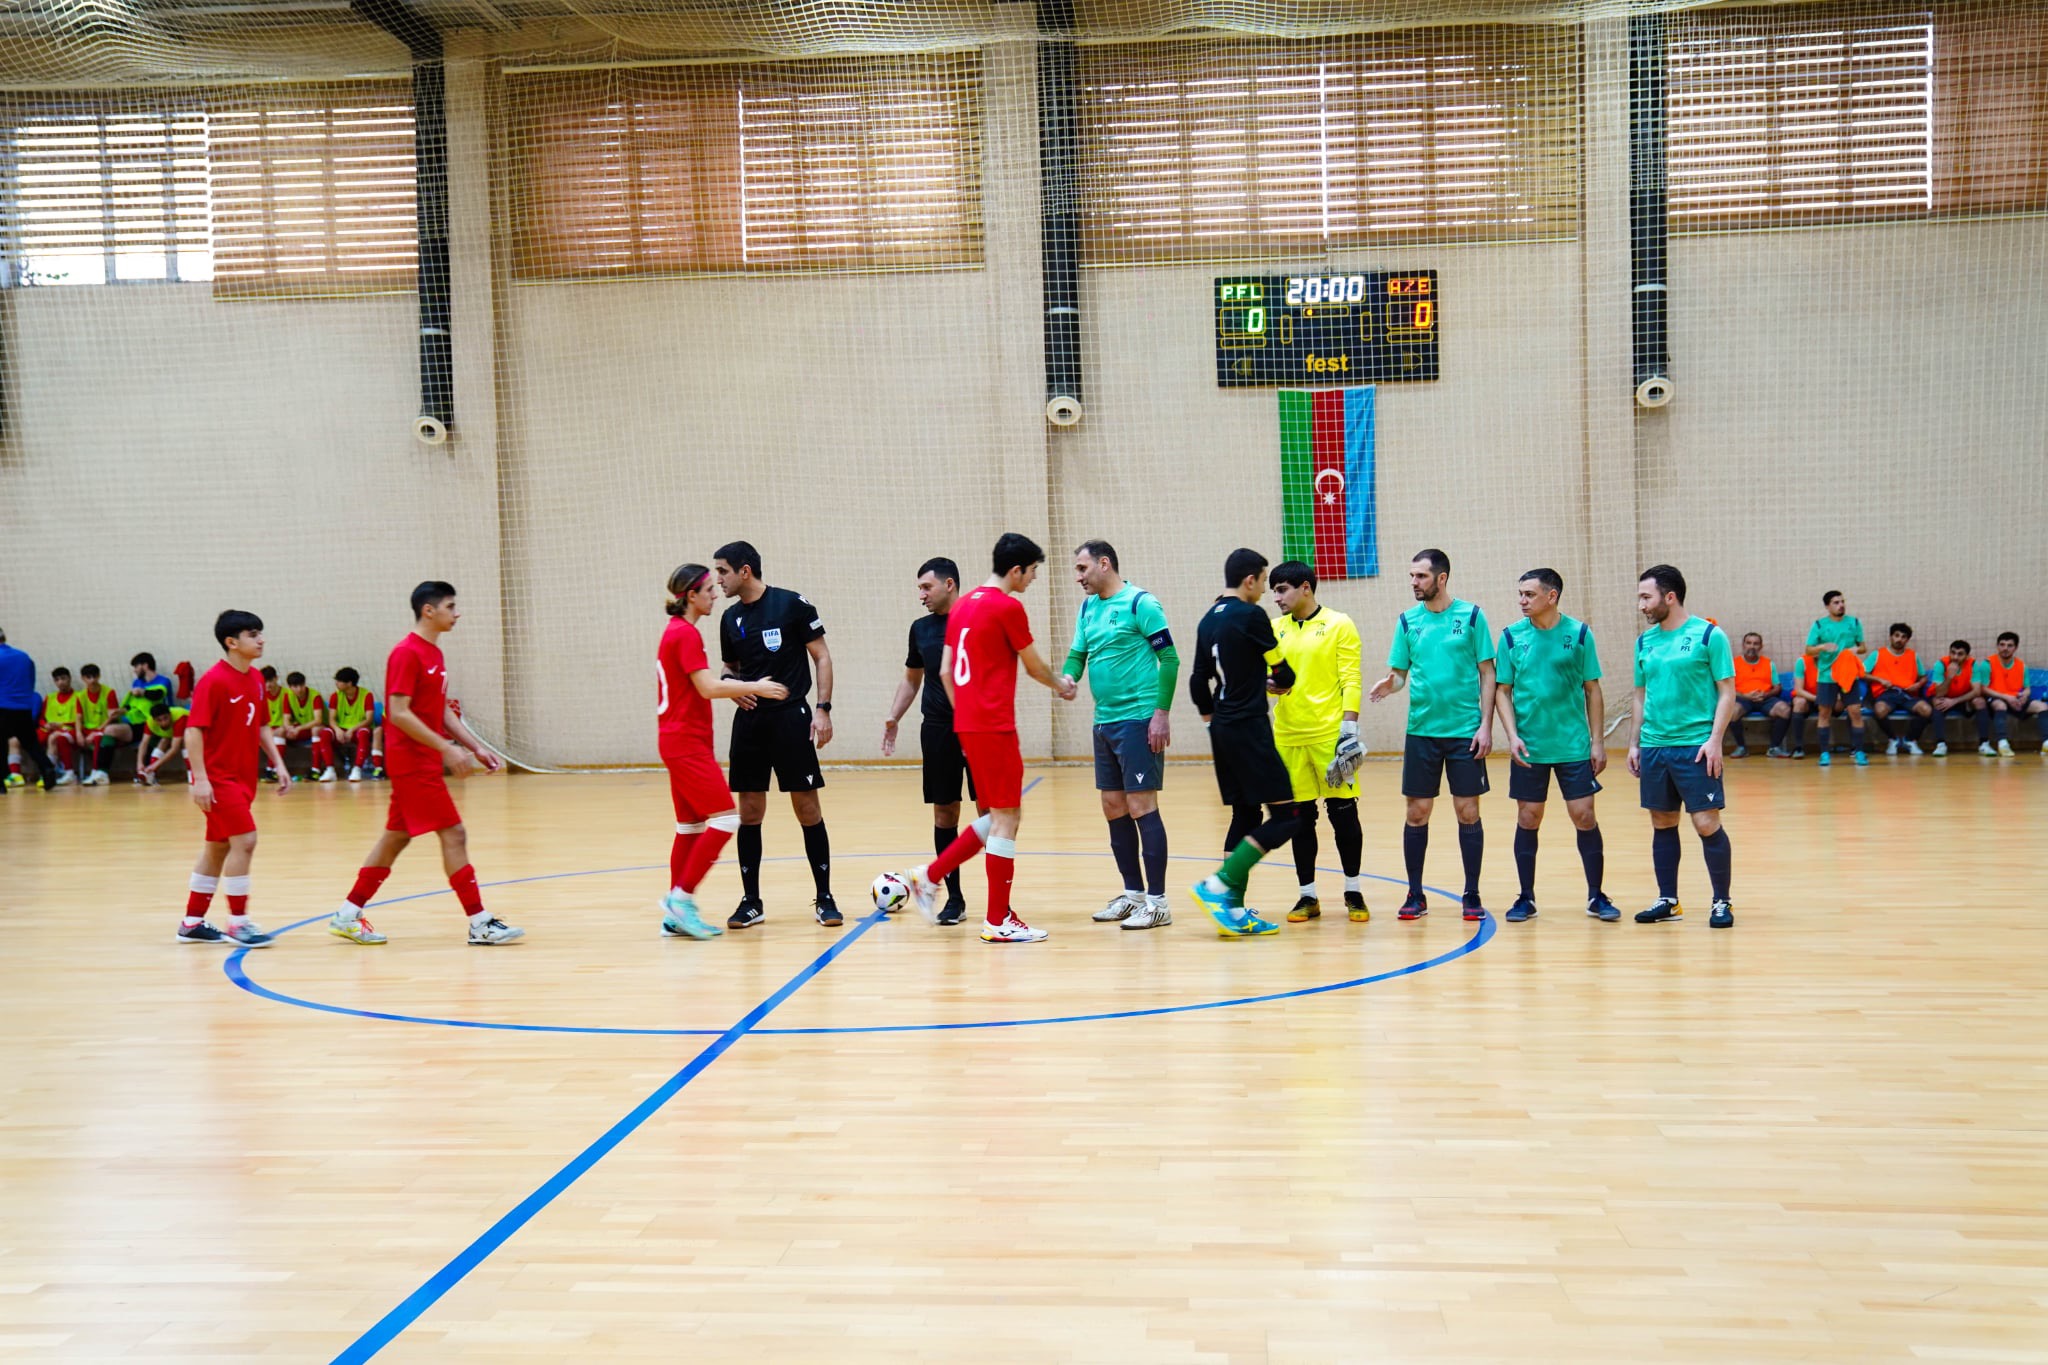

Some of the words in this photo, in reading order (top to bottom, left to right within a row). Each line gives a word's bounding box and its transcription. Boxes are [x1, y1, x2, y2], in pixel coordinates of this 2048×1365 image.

[1222, 284, 1262, 300] PFL
[1287, 276, 1365, 304] 20:00
[1247, 307, 1264, 332] 0
[1414, 300, 1432, 328] 0
[1305, 353, 1349, 373] fest
[764, 630, 779, 638] FIFA
[954, 627, 971, 686] 6
[1211, 643, 1226, 700] 1
